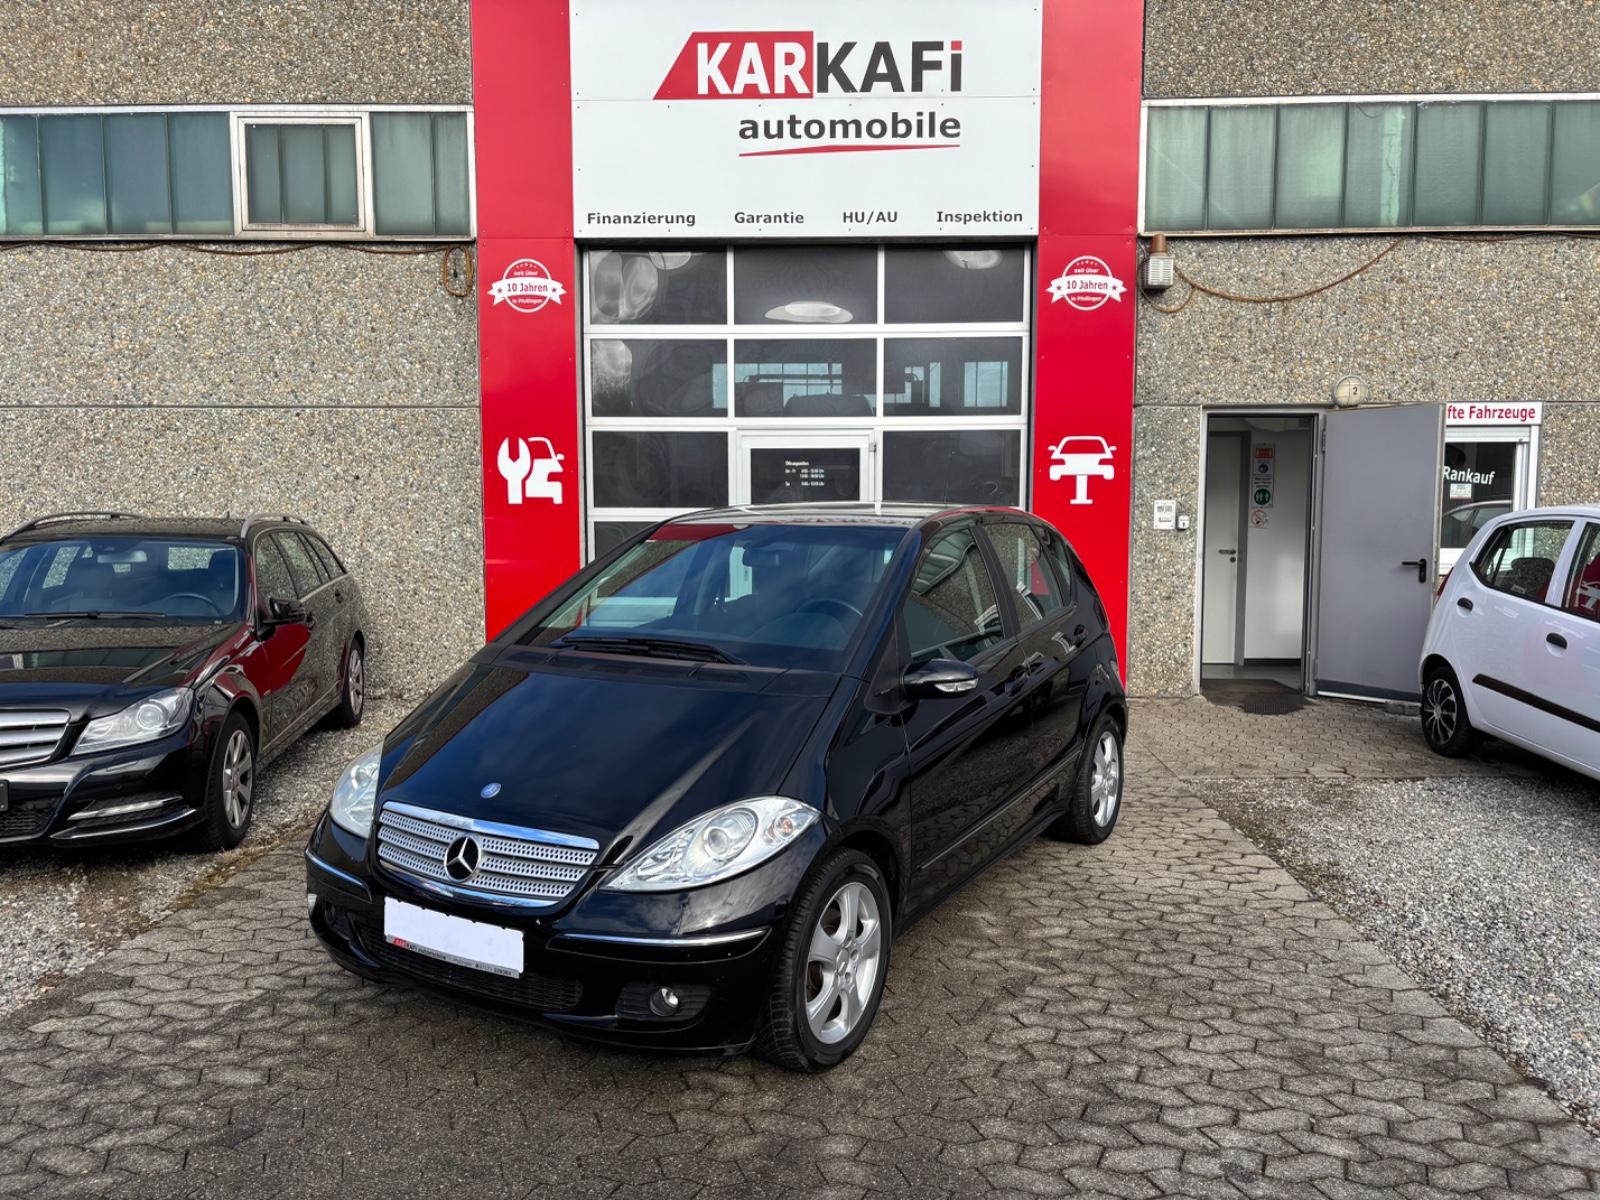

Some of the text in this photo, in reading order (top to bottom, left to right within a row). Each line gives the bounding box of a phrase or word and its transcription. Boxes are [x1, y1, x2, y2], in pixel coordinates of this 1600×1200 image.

[738, 111, 961, 140] automobile
[587, 211, 696, 227] Finanzierung
[734, 211, 805, 224] Garantie
[842, 211, 898, 225] HU/AU
[936, 210, 1023, 226] Inspektion
[507, 282, 548, 292] 10 Jahren
[1066, 279, 1108, 290] 10 Jahren
[1352, 386, 1358, 395] 2
[1469, 404, 1536, 422] Fahrzeuge
